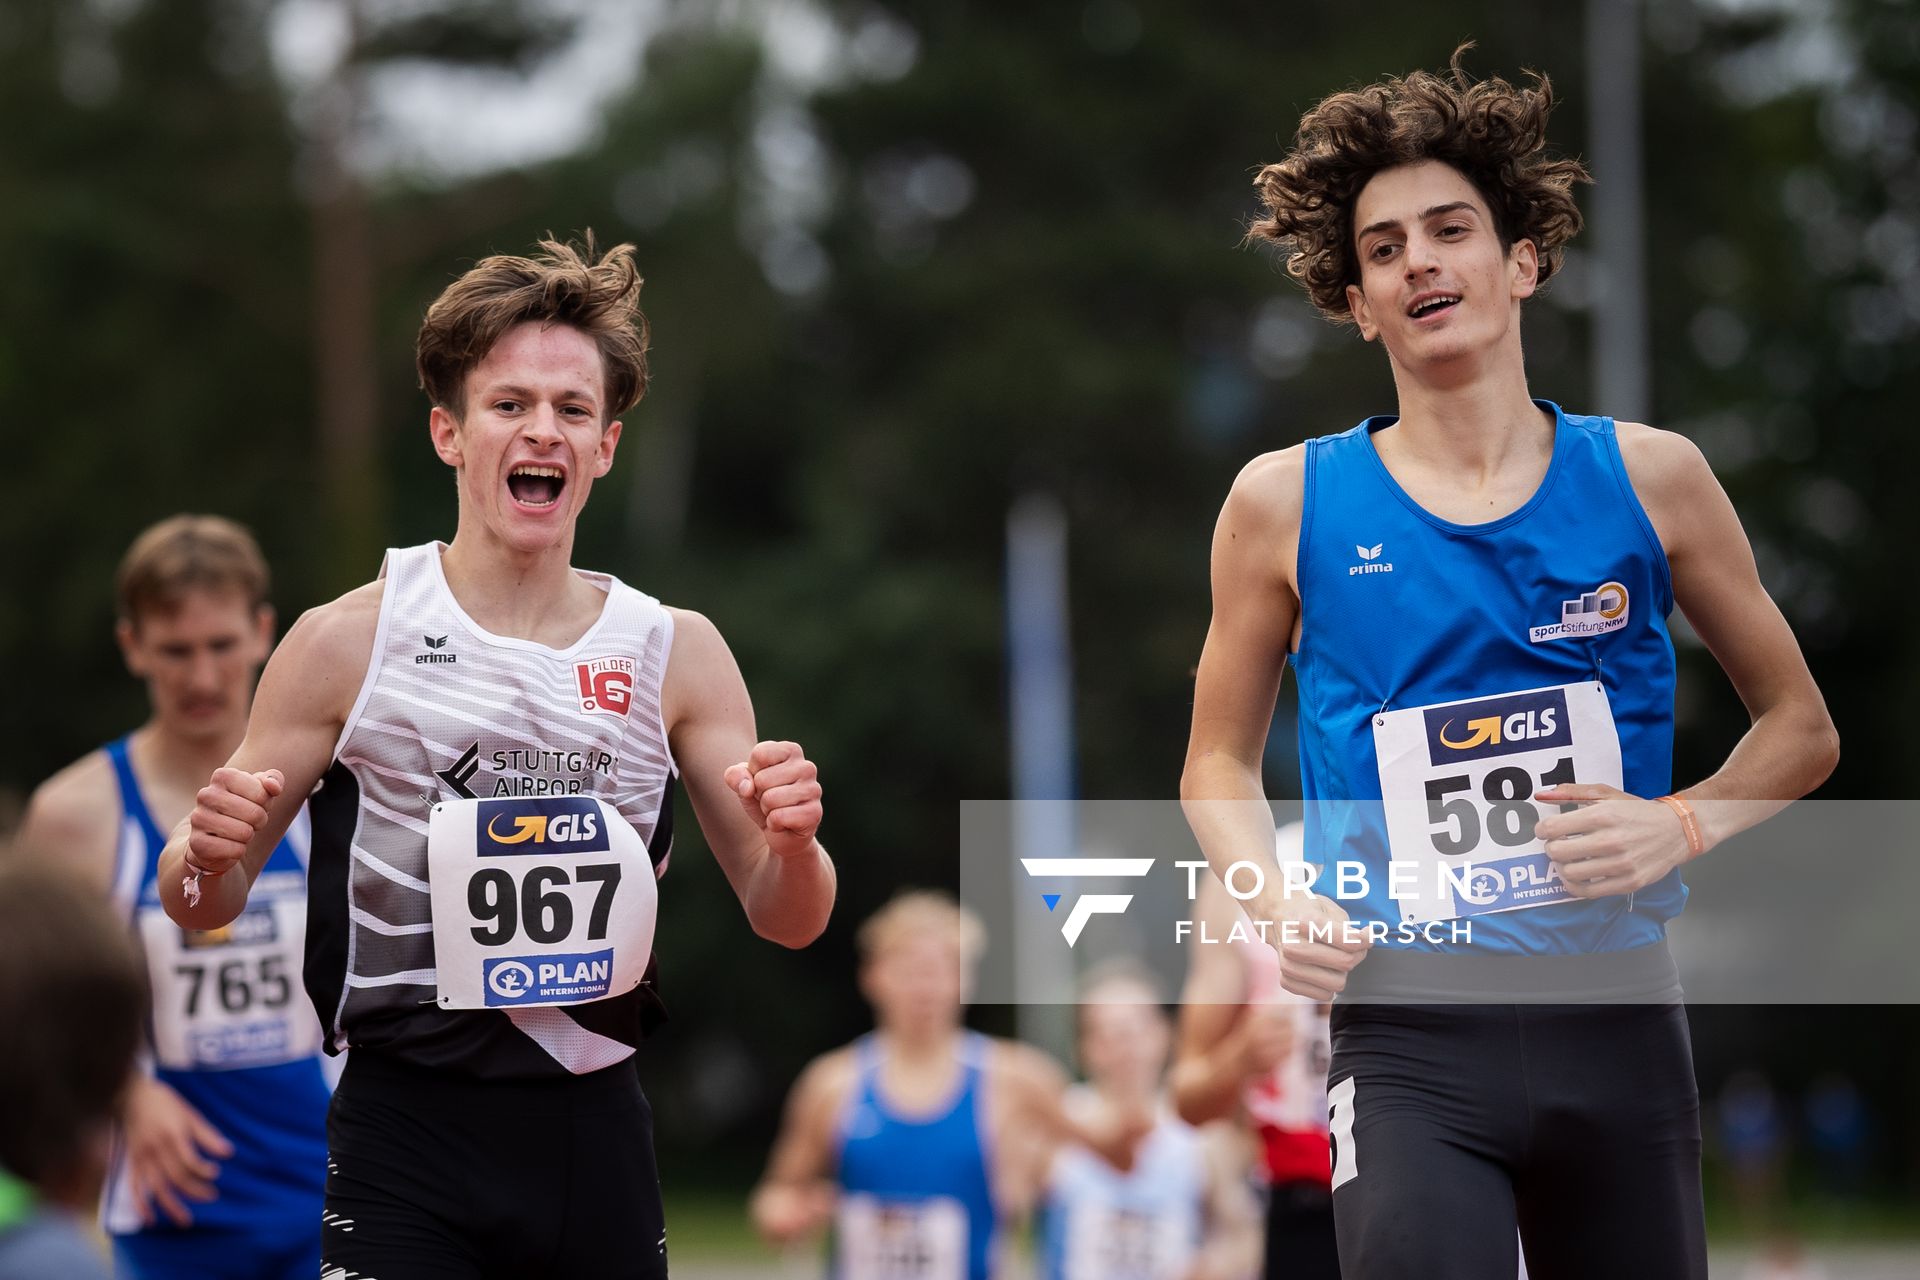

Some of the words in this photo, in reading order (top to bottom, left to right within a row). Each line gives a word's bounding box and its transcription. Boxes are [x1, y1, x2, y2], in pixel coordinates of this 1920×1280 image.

[1349, 562, 1393, 576] erima
[415, 652, 457, 664] erima
[591, 659, 633, 674] FILDER
[1503, 708, 1556, 742] GLS
[492, 750, 619, 775] STUTTGAR
[493, 776, 588, 799] AIRPOR
[1424, 757, 1579, 856] 581
[548, 813, 597, 843] GLS
[1509, 862, 1562, 888] PLA
[467, 863, 622, 947] 967
[538, 960, 608, 985] PLAN
[175, 954, 291, 1017] 765
[540, 984, 606, 996] INTERNATIONAL
